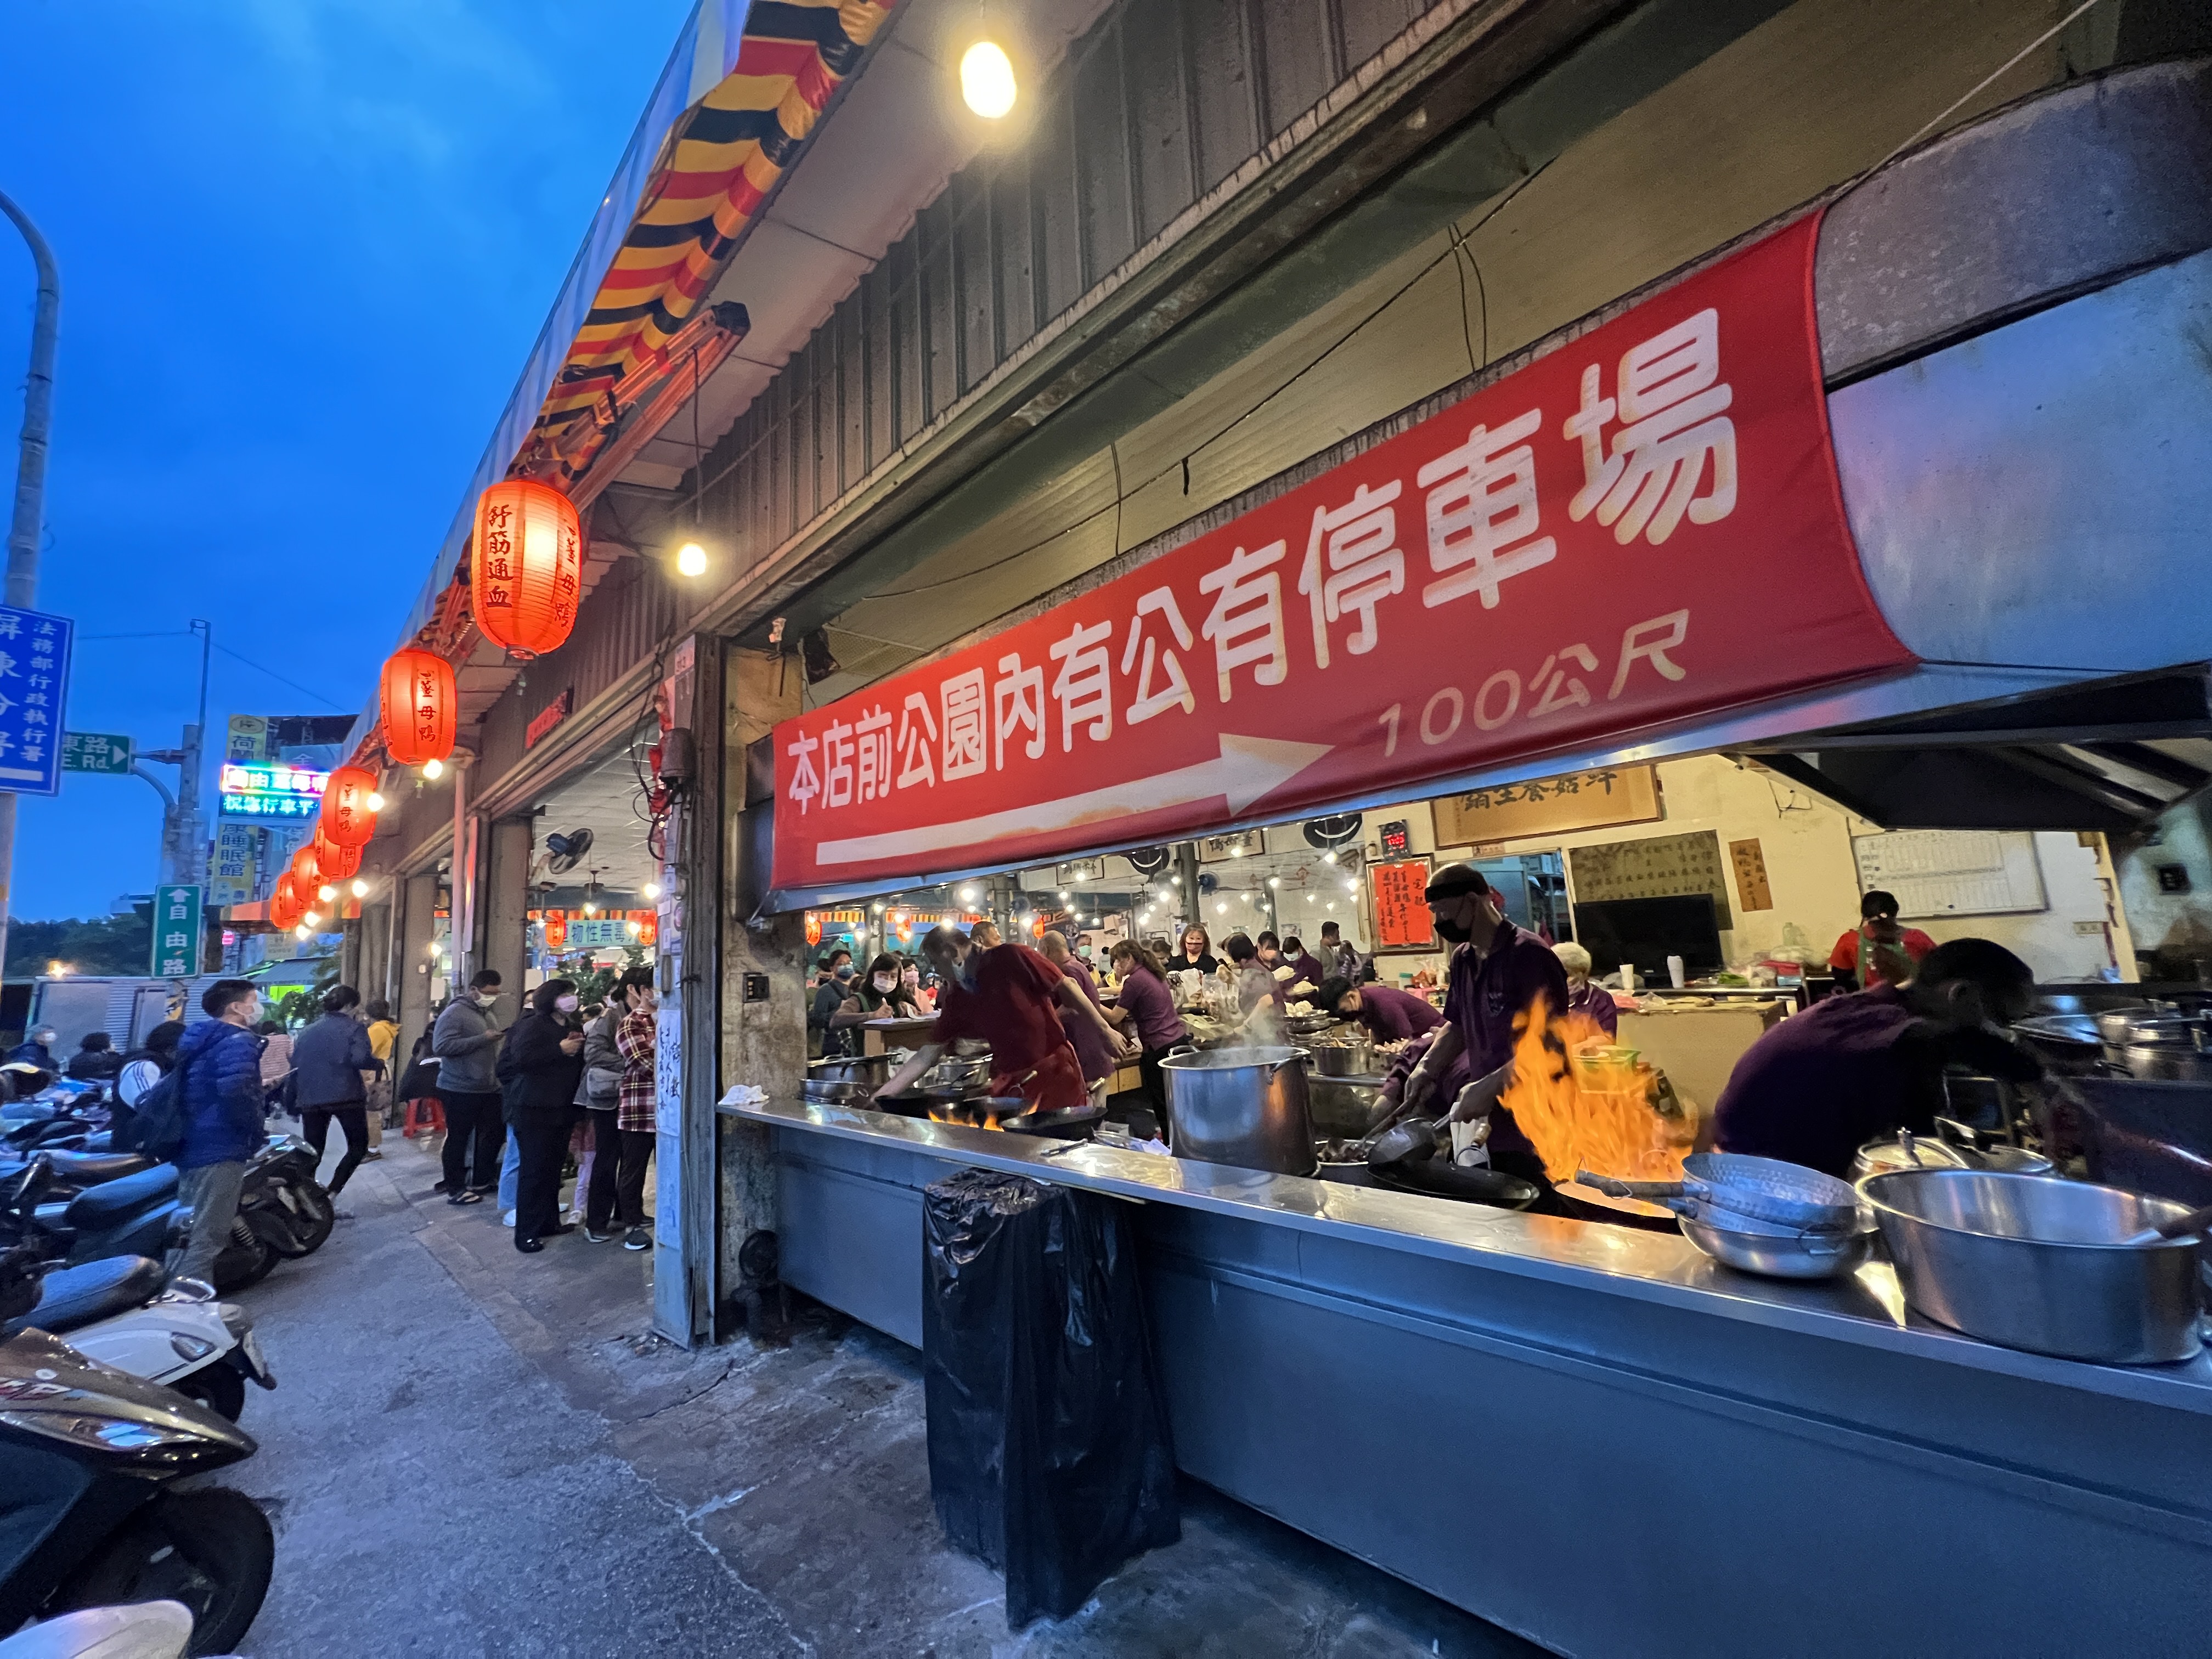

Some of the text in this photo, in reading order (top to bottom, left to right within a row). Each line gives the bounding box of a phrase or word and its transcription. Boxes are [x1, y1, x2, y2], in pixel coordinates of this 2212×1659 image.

[788, 308, 1737, 815] 本店前公園內有公有停車場
[20, 621, 57, 762] 法務部行政執行署
[163, 904, 188, 975] 自由路
